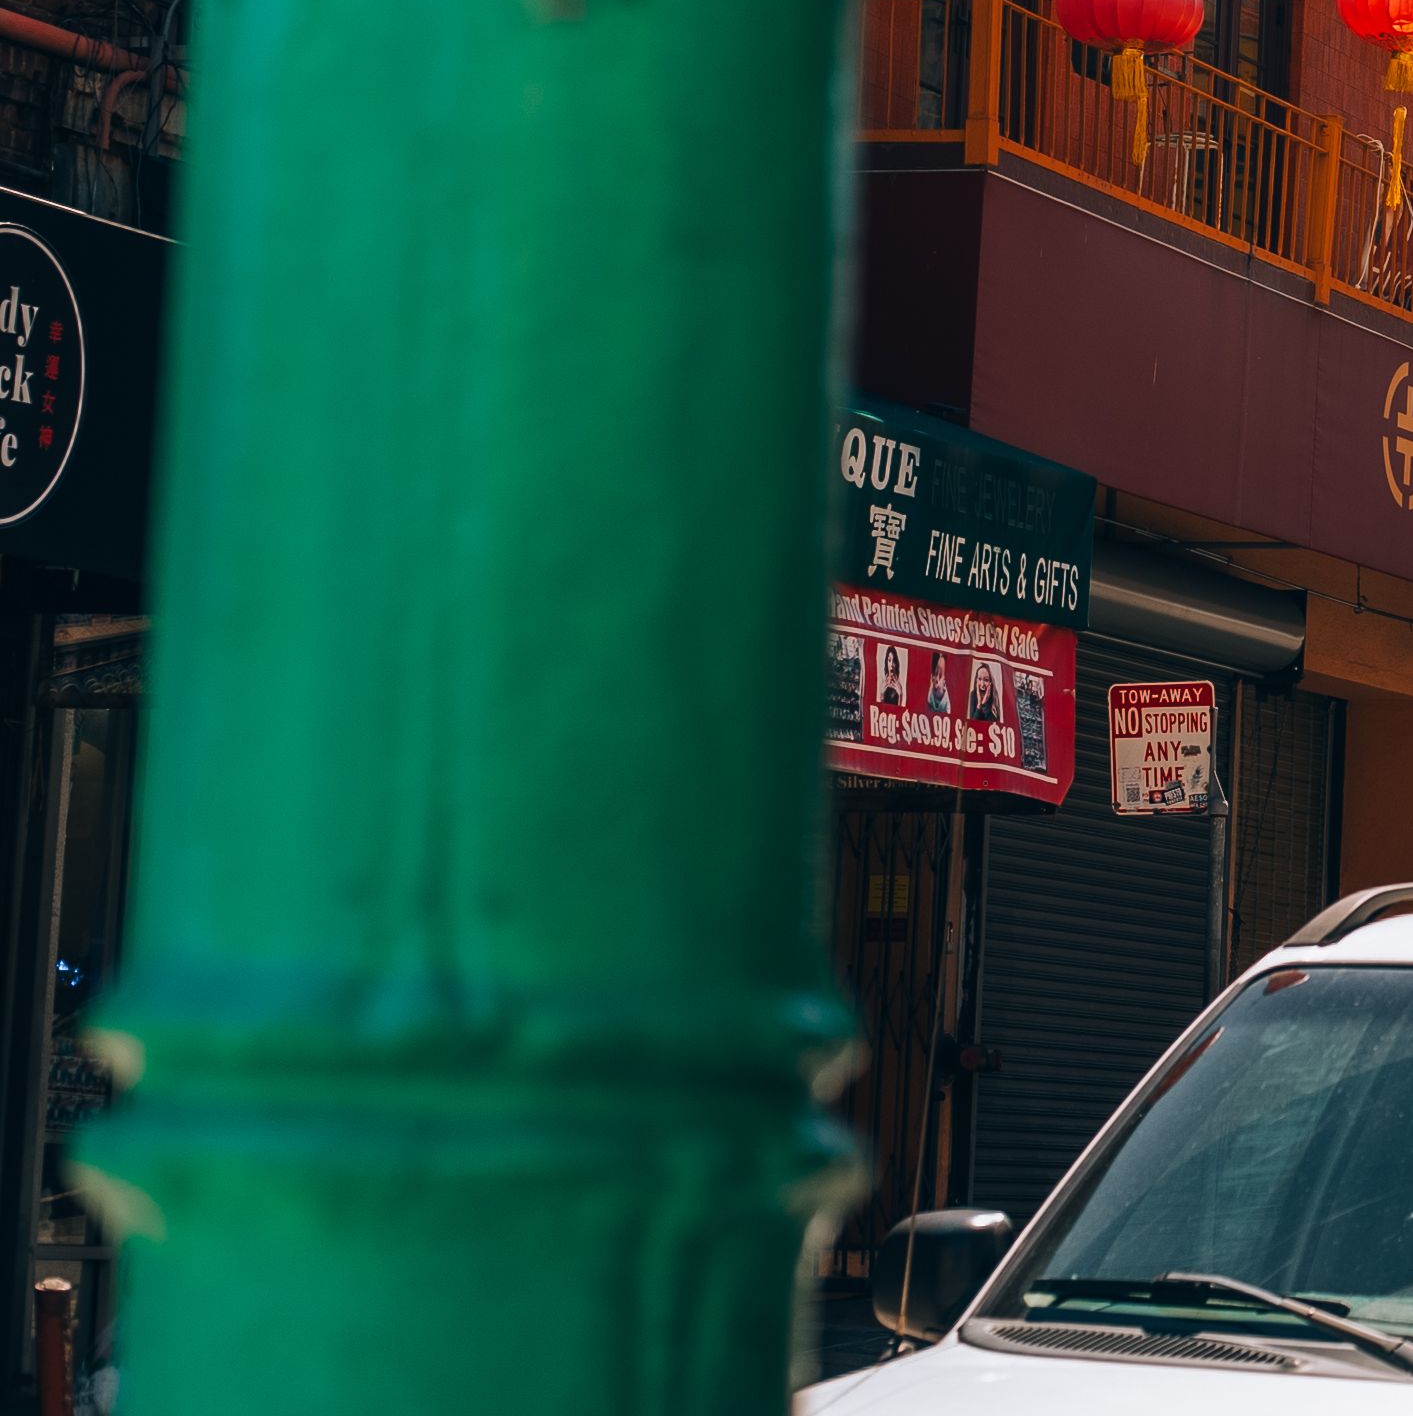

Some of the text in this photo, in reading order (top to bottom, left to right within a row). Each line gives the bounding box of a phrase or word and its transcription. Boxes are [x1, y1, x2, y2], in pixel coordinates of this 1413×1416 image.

[840, 427, 921, 498] QUE
[867, 503, 907, 580] 寶
[925, 529, 1079, 611] FINE ARTS & GIFTS
[861, 594, 918, 633] Painted
[917, 606, 961, 644] Shoes
[1009, 628, 1039, 662] Sale
[1114, 707, 1207, 735] NO STOPPING
[1119, 687, 1203, 705] TOW-AWAY
[870, 705, 901, 744] Reg:
[901, 709, 953, 751] $49.99,
[988, 721, 1015, 759] $10
[1144, 741, 1181, 762] ANY
[1142, 766, 1185, 788] TIME
